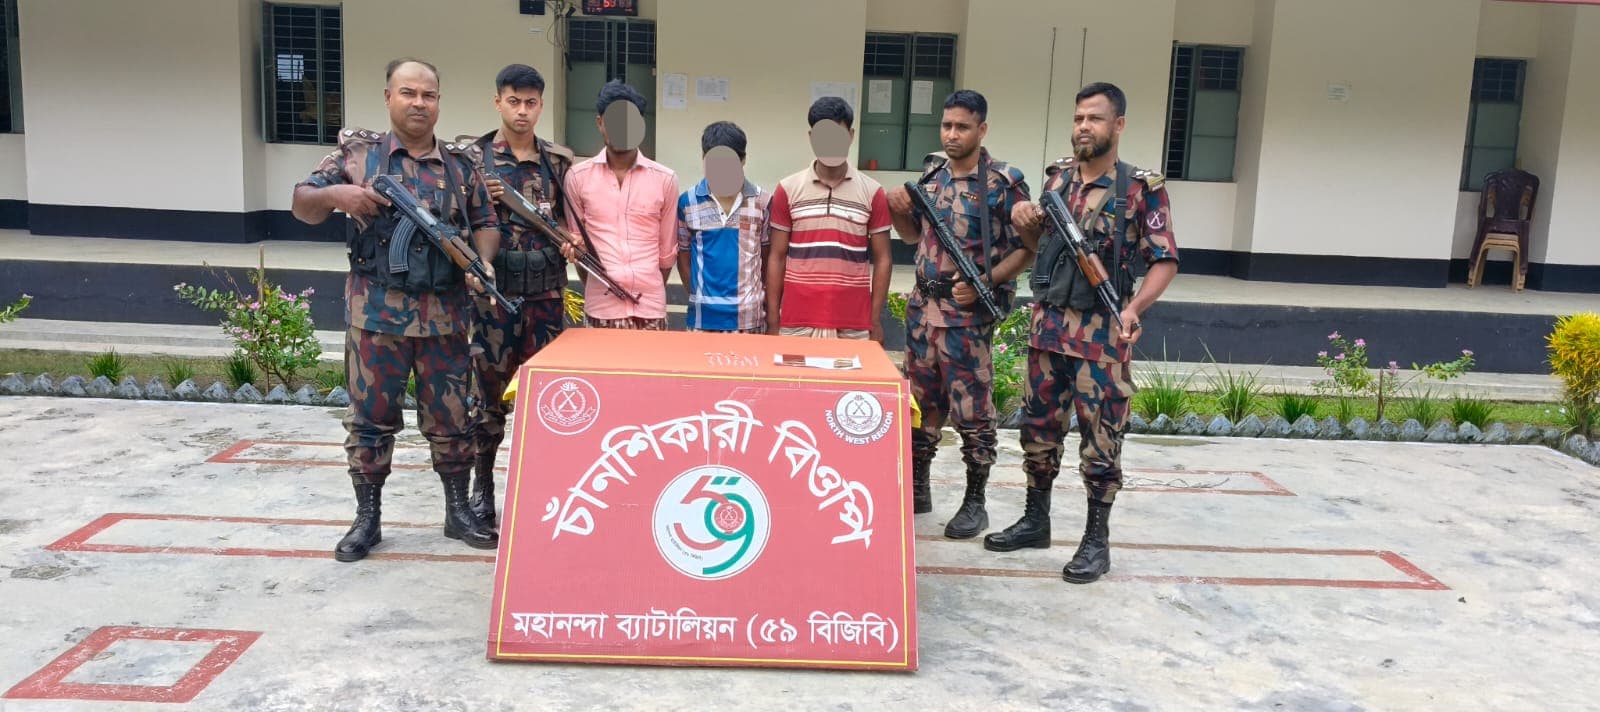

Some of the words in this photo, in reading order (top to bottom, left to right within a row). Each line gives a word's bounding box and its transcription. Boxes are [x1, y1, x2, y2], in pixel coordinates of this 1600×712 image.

[824, 409, 845, 439] NORTH
[845, 433, 870, 445] WEST
[870, 411, 894, 442] REGION
[768, 419, 874, 550] বিওপি
[511, 611, 609, 640] মহানন্দা
[746, 613, 798, 650] (৫৯
[807, 610, 899, 653] বিজিবি)
